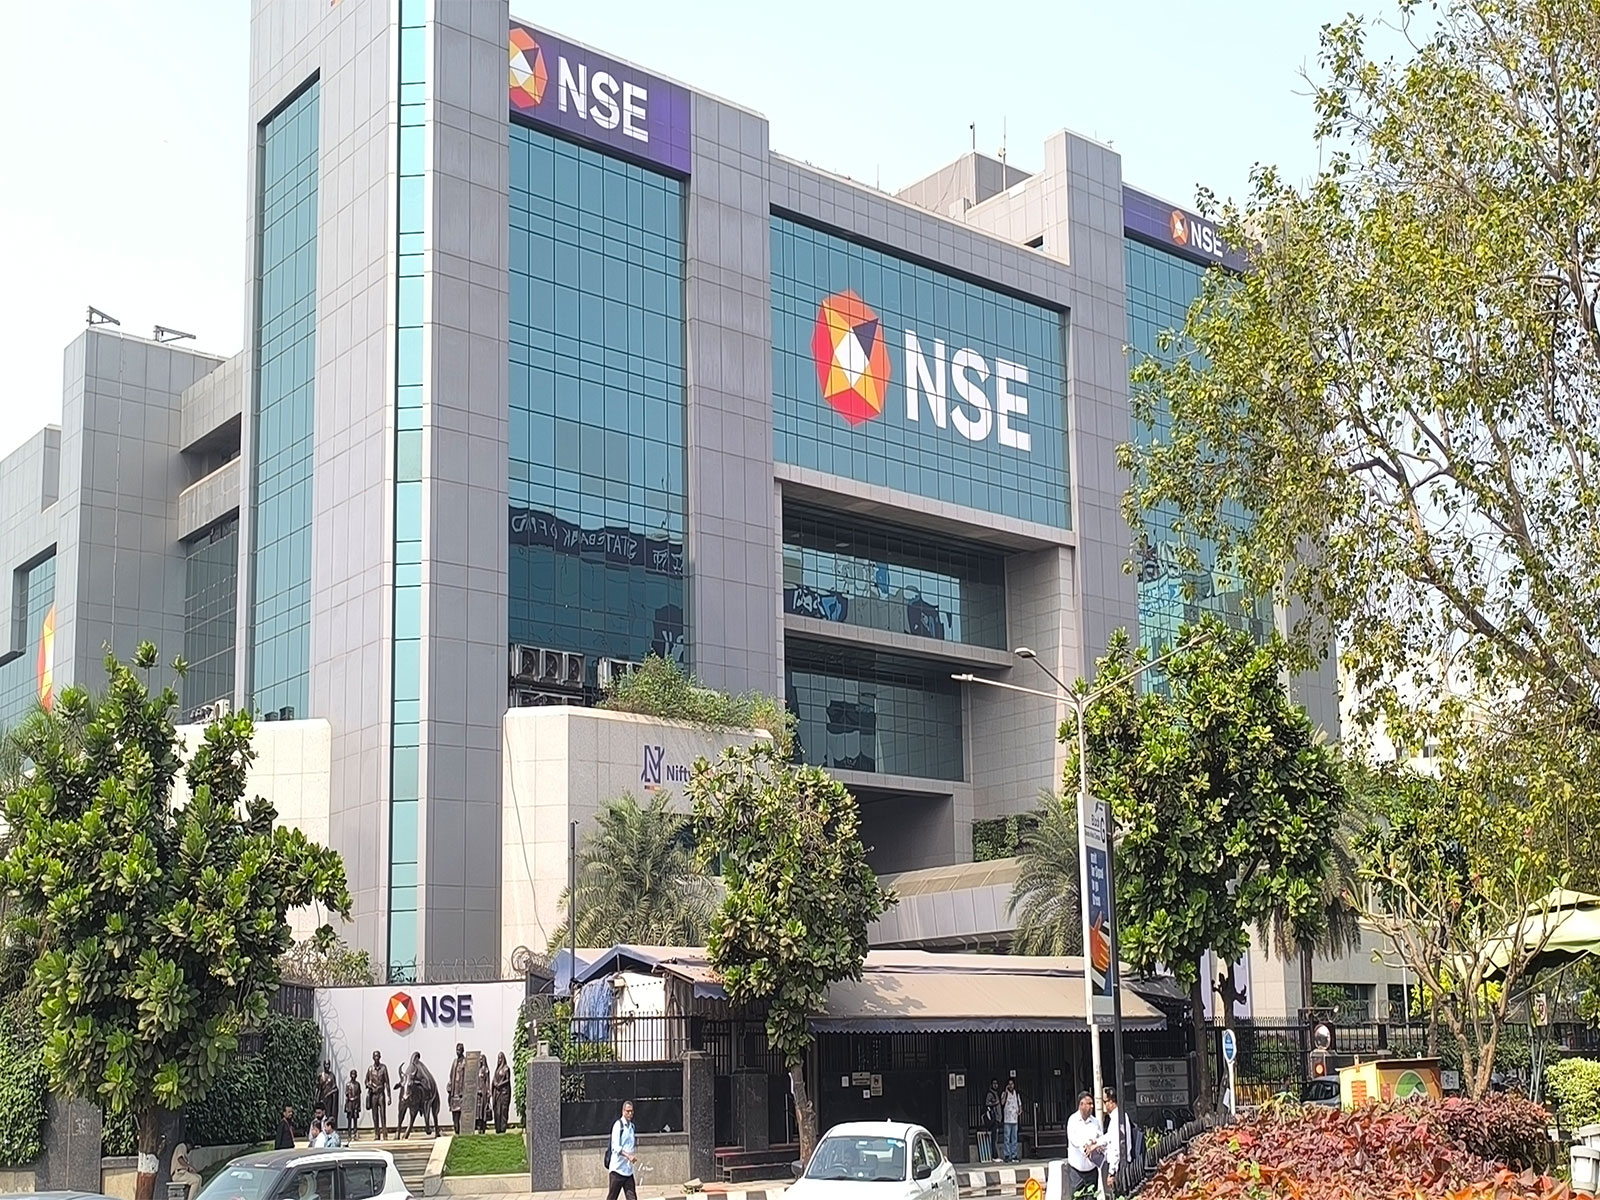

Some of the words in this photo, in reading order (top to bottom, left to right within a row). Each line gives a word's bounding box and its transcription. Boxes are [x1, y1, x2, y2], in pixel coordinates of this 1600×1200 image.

[557, 55, 649, 143] NSE
[1190, 220, 1224, 258] NSE
[904, 328, 1032, 452] NSE
[420, 994, 472, 1024] NSE
